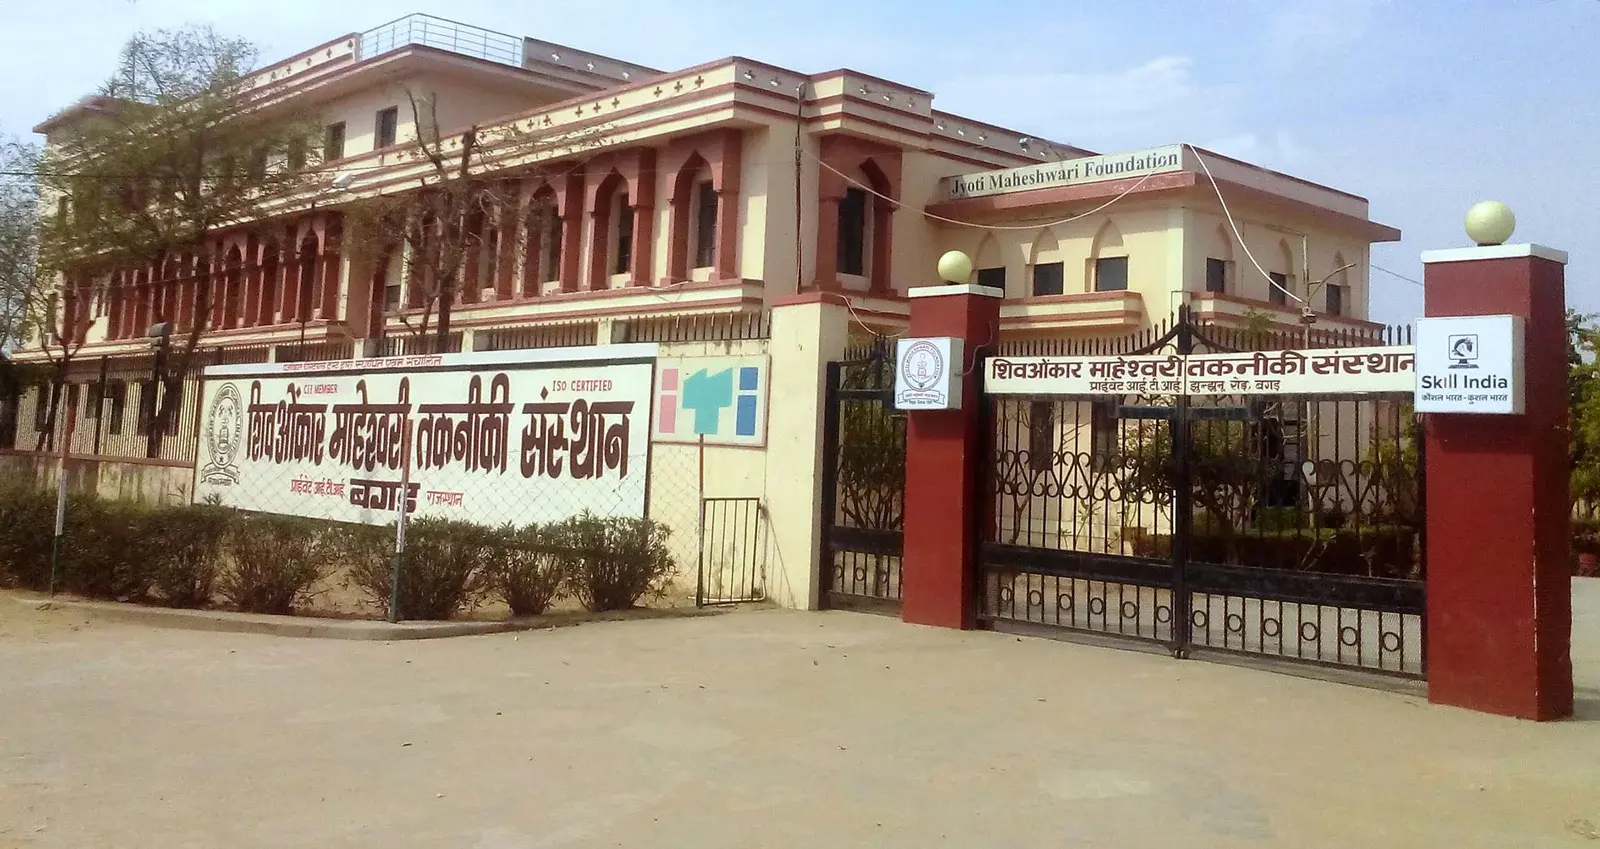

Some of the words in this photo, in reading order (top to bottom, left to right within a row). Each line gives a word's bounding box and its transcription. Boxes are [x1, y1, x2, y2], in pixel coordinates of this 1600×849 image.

[951, 177, 985, 196] Jyoti
[989, 164, 1079, 189] Maheshwari
[1084, 152, 1178, 177] Foundation
[992, 358, 1083, 380] शिवओंकार
[1089, 355, 1184, 379] माहेश्वरी
[1187, 350, 1308, 376] तकनीकी
[1311, 350, 1415, 374] संस्थान
[314, 383, 338, 394] MEMBER
[552, 380, 567, 391] ISO
[571, 379, 613, 392] CERTIFIED
[1421, 373, 1457, 389] Skill
[1464, 374, 1508, 389] India
[1489, 393, 1508, 401] भारत
[246, 380, 328, 466] शिवओंकार
[329, 376, 412, 472] माहेश्वरी
[416, 373, 516, 476] तकनीकी
[520, 386, 635, 480] संस्थान
[426, 490, 464, 507] राजस्थान
